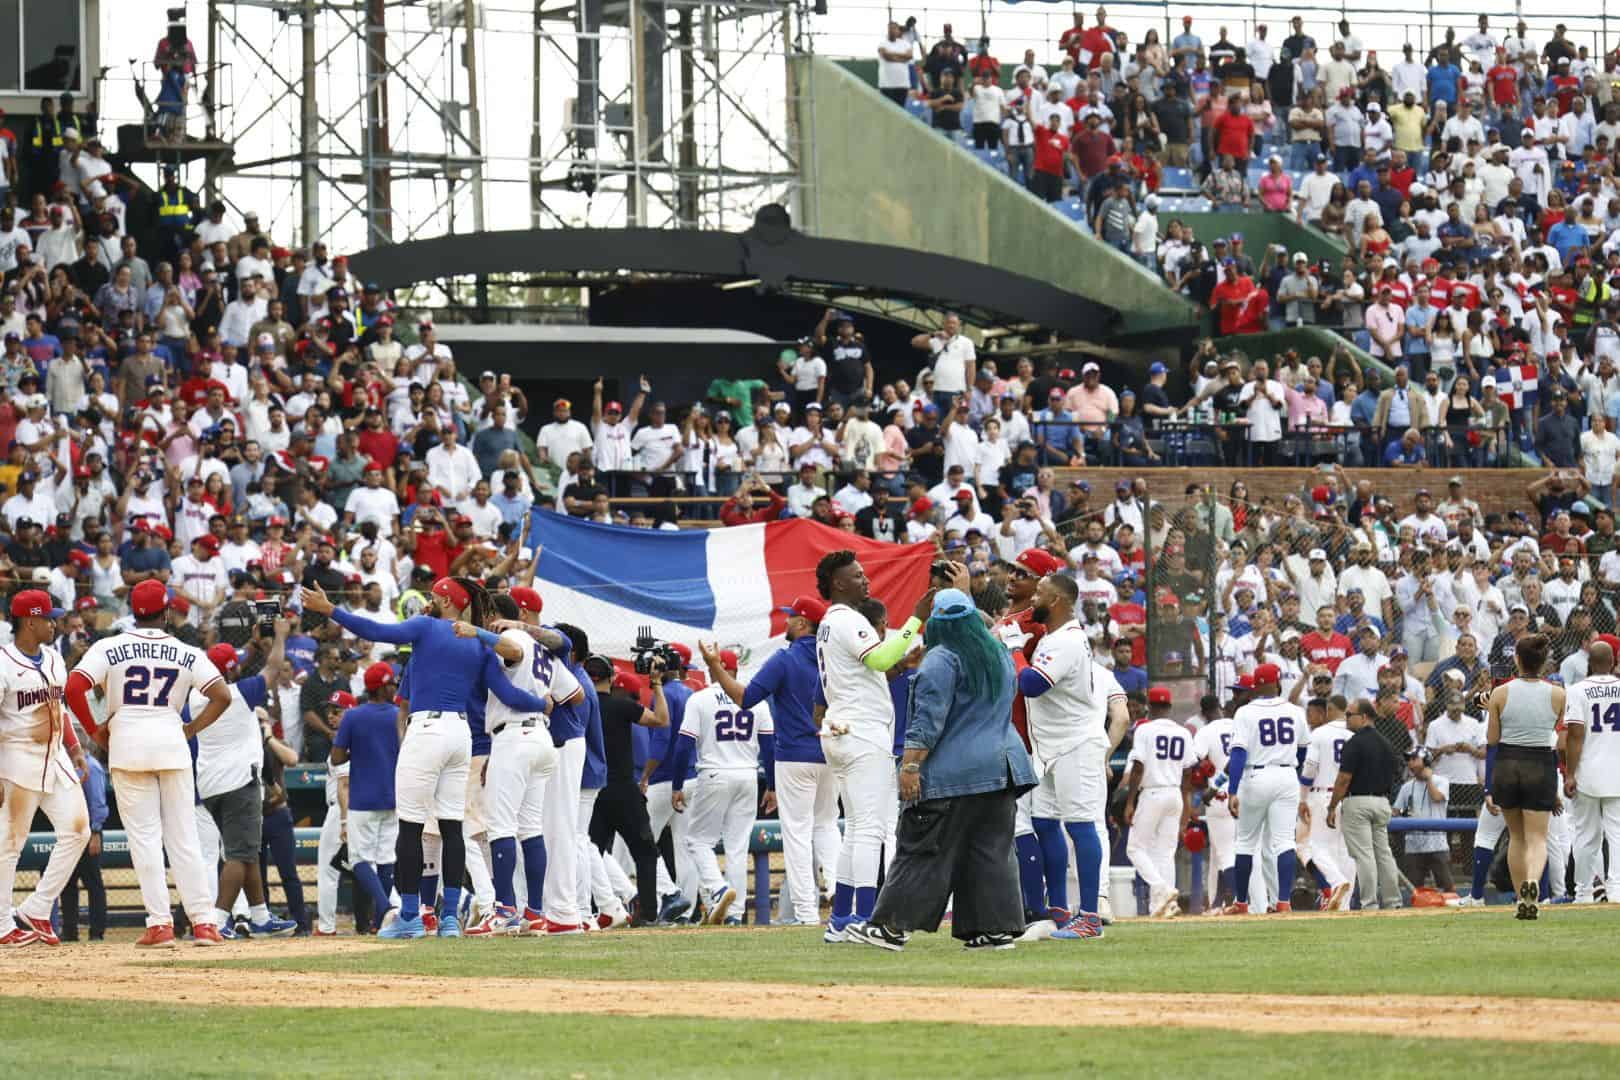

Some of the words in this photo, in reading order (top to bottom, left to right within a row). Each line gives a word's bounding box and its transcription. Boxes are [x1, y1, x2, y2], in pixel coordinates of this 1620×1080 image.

[105, 642, 178, 666] GUERRERO
[123, 665, 180, 707] 27
[714, 710, 755, 742] 29
[1258, 717, 1296, 747] 86
[1590, 702, 1620, 733] 14
[1155, 735, 1185, 761] 90
